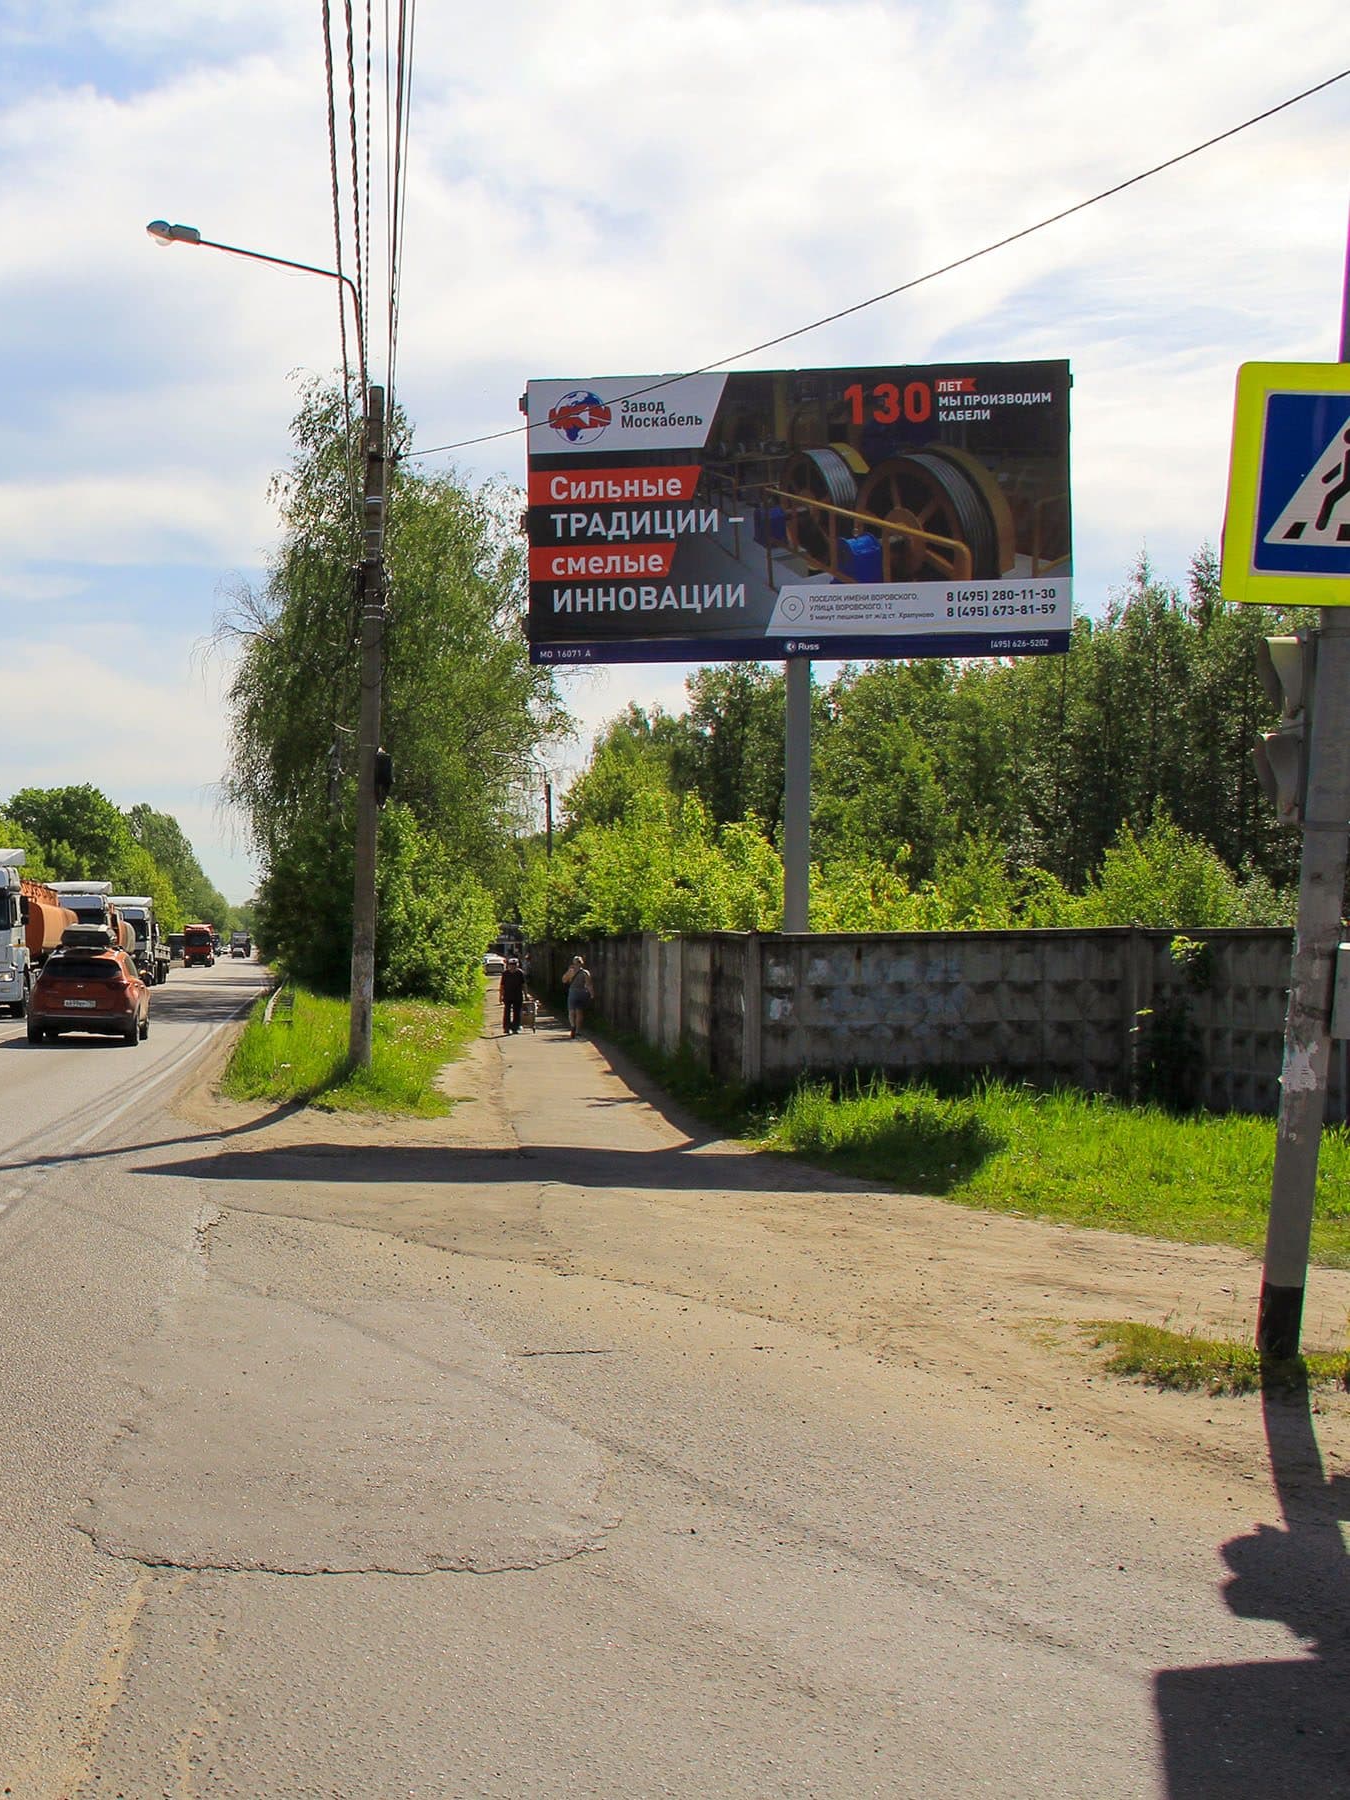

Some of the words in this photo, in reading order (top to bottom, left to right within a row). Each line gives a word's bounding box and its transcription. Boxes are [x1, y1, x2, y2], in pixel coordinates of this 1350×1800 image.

[937, 380, 963, 392] ЛЕТ
[843, 381, 932, 425] 130
[938, 396, 961, 407] МЫ
[963, 392, 1052, 406] ПРОИЗВОДИМ
[620, 400, 665, 414] Завод
[620, 412, 703, 428] Москабель
[938, 409, 991, 422] КАБЕЛИ
[550, 476, 682, 501] Сильные
[550, 508, 719, 541] ТРАДИЦИИ
[551, 554, 664, 576] смелые
[553, 583, 745, 614] ИННОВАЦИИ
[946, 591, 954, 602] 8
[957, 590, 988, 602] (495)
[992, 588, 1056, 601] 280-11-30
[946, 607, 954, 617] 8
[957, 606, 989, 618] (495)
[992, 604, 1056, 616] 673-81-59
[798, 642, 820, 651] Russ
[1012, 639, 1049, 648] 626-5202
[557, 650, 581, 658] 16071
